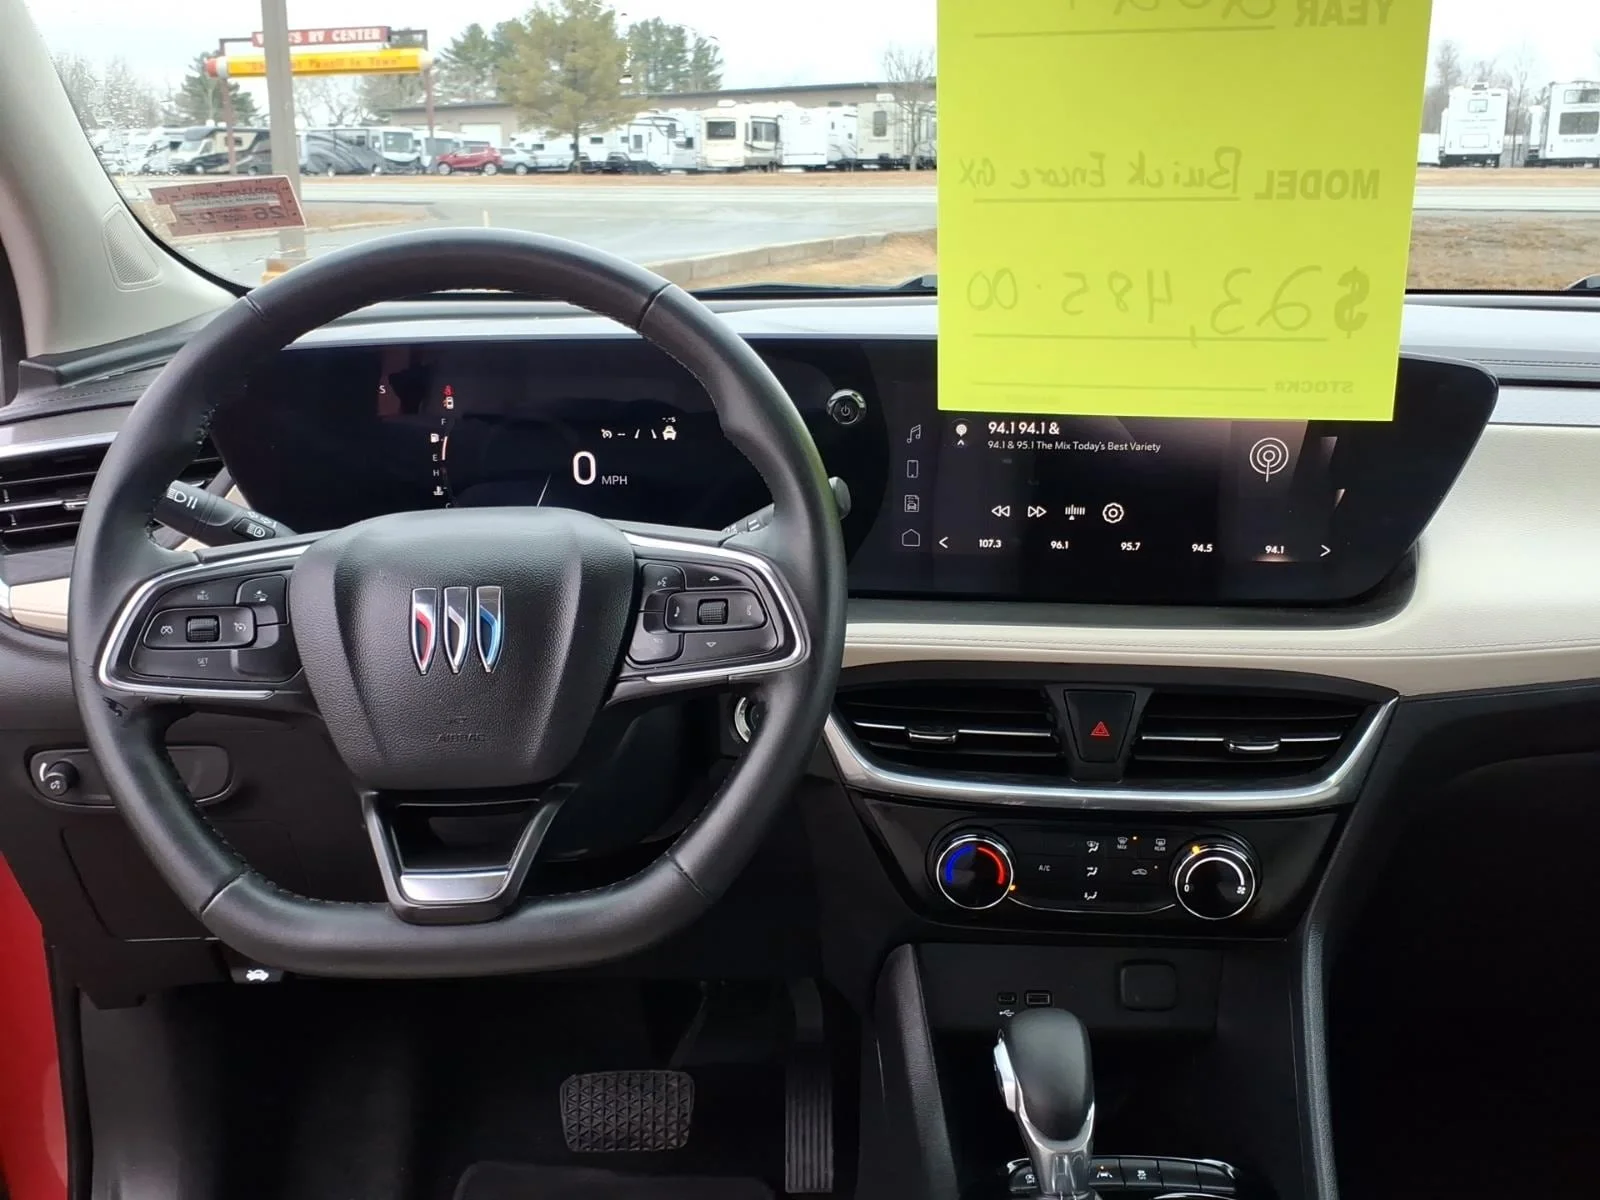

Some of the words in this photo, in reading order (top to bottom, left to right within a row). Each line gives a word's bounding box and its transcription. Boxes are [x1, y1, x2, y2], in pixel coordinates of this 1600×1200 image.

[308, 29, 325, 43] RV
[332, 27, 381, 42] CENTER
[378, 384, 387, 394] S
[440, 417, 447, 426] F
[987, 421, 1015, 435] 94.1
[1018, 421, 1045, 435] 94.1
[1048, 422, 1060, 435] &
[987, 440, 1006, 449] 94.1
[1007, 441, 1015, 449] &
[1016, 441, 1035, 449] 95.1
[1036, 441, 1053, 450] The
[1054, 441, 1071, 450] Mix
[1072, 441, 1106, 452] Today's
[1107, 442, 1128, 451] Best
[1129, 442, 1161, 453] Variety
[432, 454, 438, 462] E
[432, 469, 440, 477] H
[572, 450, 597, 486] 0
[601, 475, 628, 485] MPH
[978, 538, 1002, 549] 107.3
[1050, 540, 1070, 550] 96.1
[1120, 541, 1141, 551] 95.7
[1191, 543, 1213, 553] 94.5
[1264, 545, 1285, 555] 94.1
[1038, 864, 1051, 872] A/C
